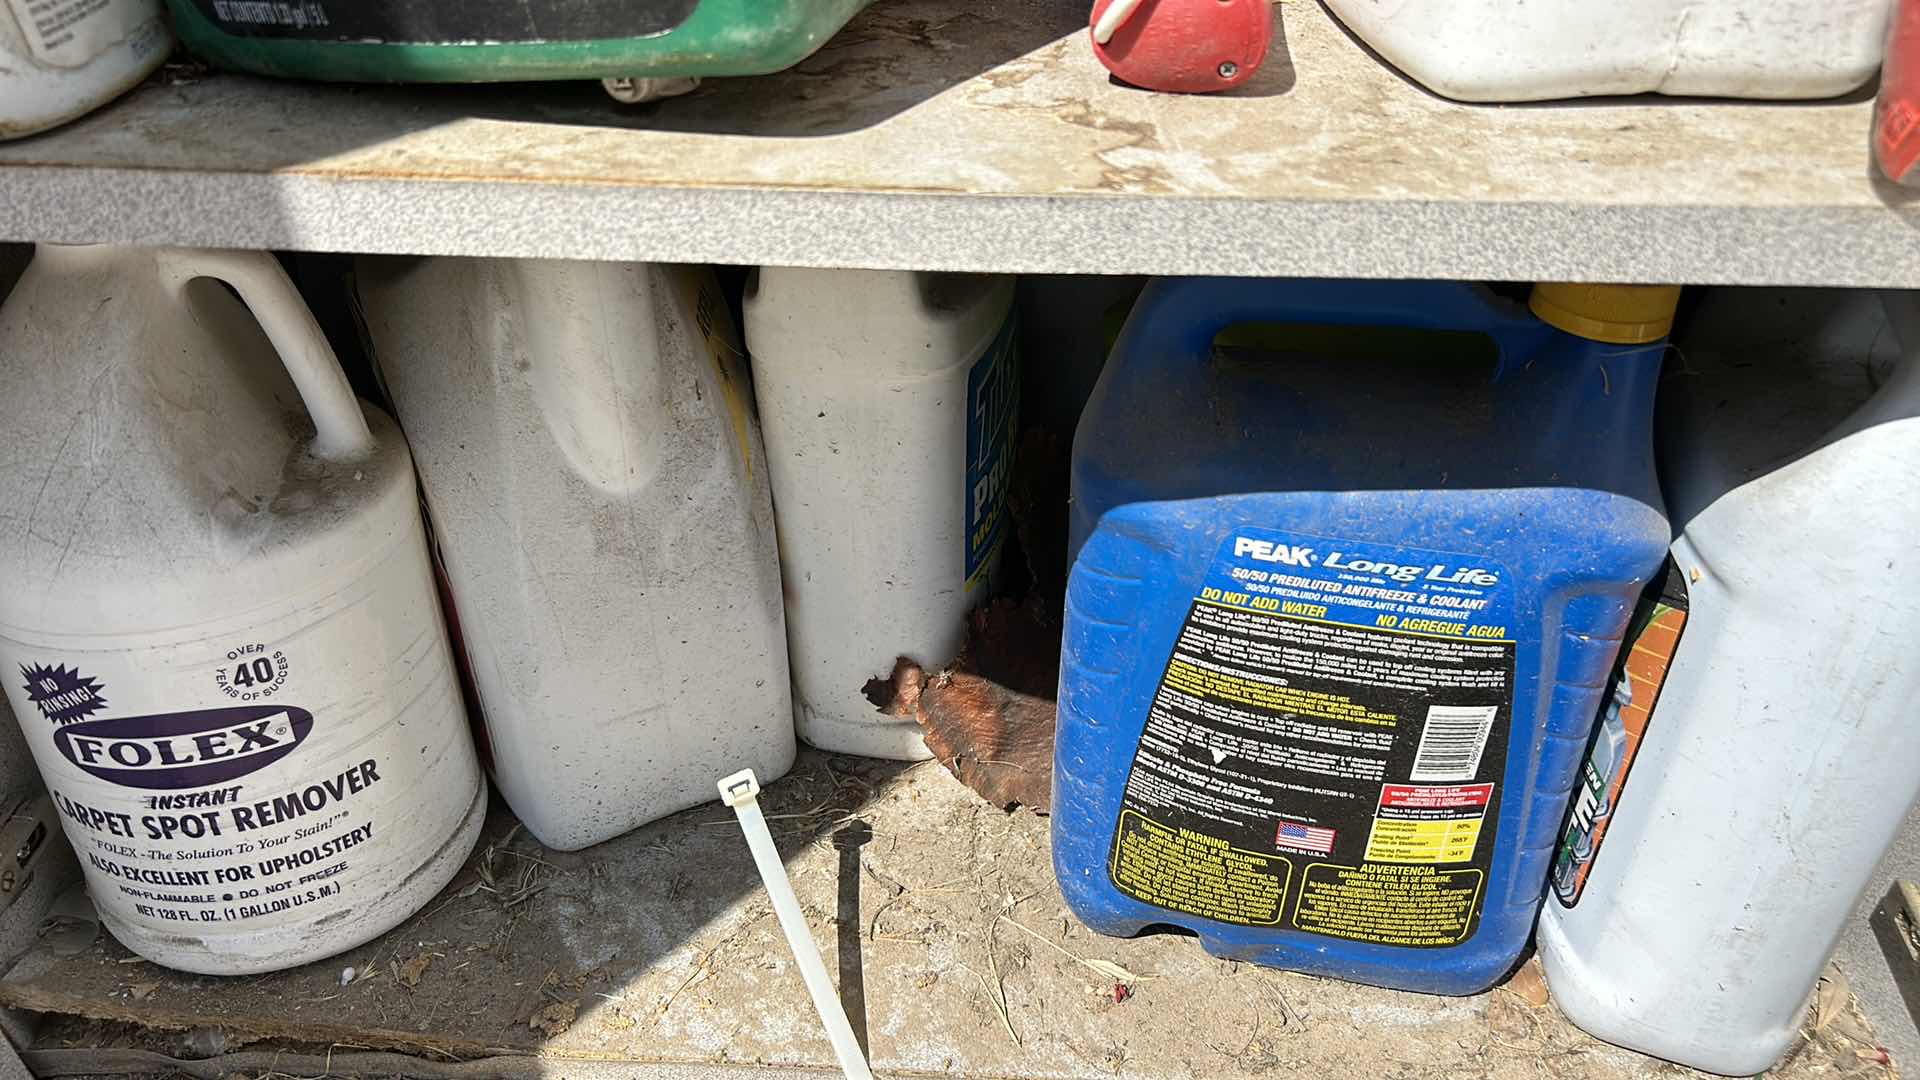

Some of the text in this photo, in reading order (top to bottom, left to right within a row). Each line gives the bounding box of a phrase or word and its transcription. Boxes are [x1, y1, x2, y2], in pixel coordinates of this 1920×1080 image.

[1322, 552, 1498, 585] Long Life
[1202, 587, 1328, 617] DO NOT ADD WATER
[1231, 567, 1487, 610] 50/50 PREDILUTED ANTIFREEZE & COOLANT
[1245, 583, 1470, 620] 50/50 PREDILUIDO ANTICONGELANTE & REFRIGERANTE
[1342, 630, 1366, 639] Coolant
[1376, 614, 1505, 638] NO AGREGUE AGUA
[227, 643, 265, 661] OVER
[40, 677, 59, 694] NO
[215, 650, 289, 701] YEARS OF SUCCESS
[234, 657, 275, 688] 40
[40, 686, 96, 715] RINSING!
[1157, 765, 1178, 777] ASTM
[1207, 784, 1221, 792] and
[1222, 788, 1243, 798] ASTM
[1229, 782, 1260, 795] Formula
[54, 757, 382, 841] CARPET SPOT REMOVER
[149, 785, 244, 810] INSTANT
[148, 850, 173, 861] The
[176, 846, 233, 861] Solution
[236, 843, 254, 854] To
[258, 834, 290, 851] Your
[1141, 821, 1174, 841] HARMFUL
[1175, 836, 1186, 846] OR
[1187, 840, 1209, 853] FATAL
[1219, 850, 1268, 867] SWALLOWED.
[1150, 835, 1256, 872] CONTAINS ETHYLENE GLYCOL.
[1179, 828, 1230, 850] WARNING
[1276, 846, 1297, 854] MADE
[89, 821, 375, 887] ALSO EXCELLENT FOR UPHOLSTERY
[119, 860, 350, 904] NON-FLAMMABLE DO NOT FREEZE
[1339, 871, 1368, 880] DAÑINO
[1376, 874, 1399, 883] FATAL
[1346, 879, 1383, 889] CONTIENE
[1384, 882, 1411, 890] ETILEN
[1360, 864, 1436, 876] ADVERTENCIA
[135, 882, 342, 923] NET 128 FL. OZ. (1 GALLON U.S.M.)
[1135, 889, 1152, 900] KEEP
[1154, 896, 1167, 906] OUT
[1169, 900, 1178, 909] OF
[1179, 903, 1202, 914] REACH
[1214, 912, 1250, 924] CHILDREN.
[1347, 930, 1368, 940] FUERA
[1369, 934, 1381, 942] DEL
[1382, 935, 1412, 944] ALCANCE
